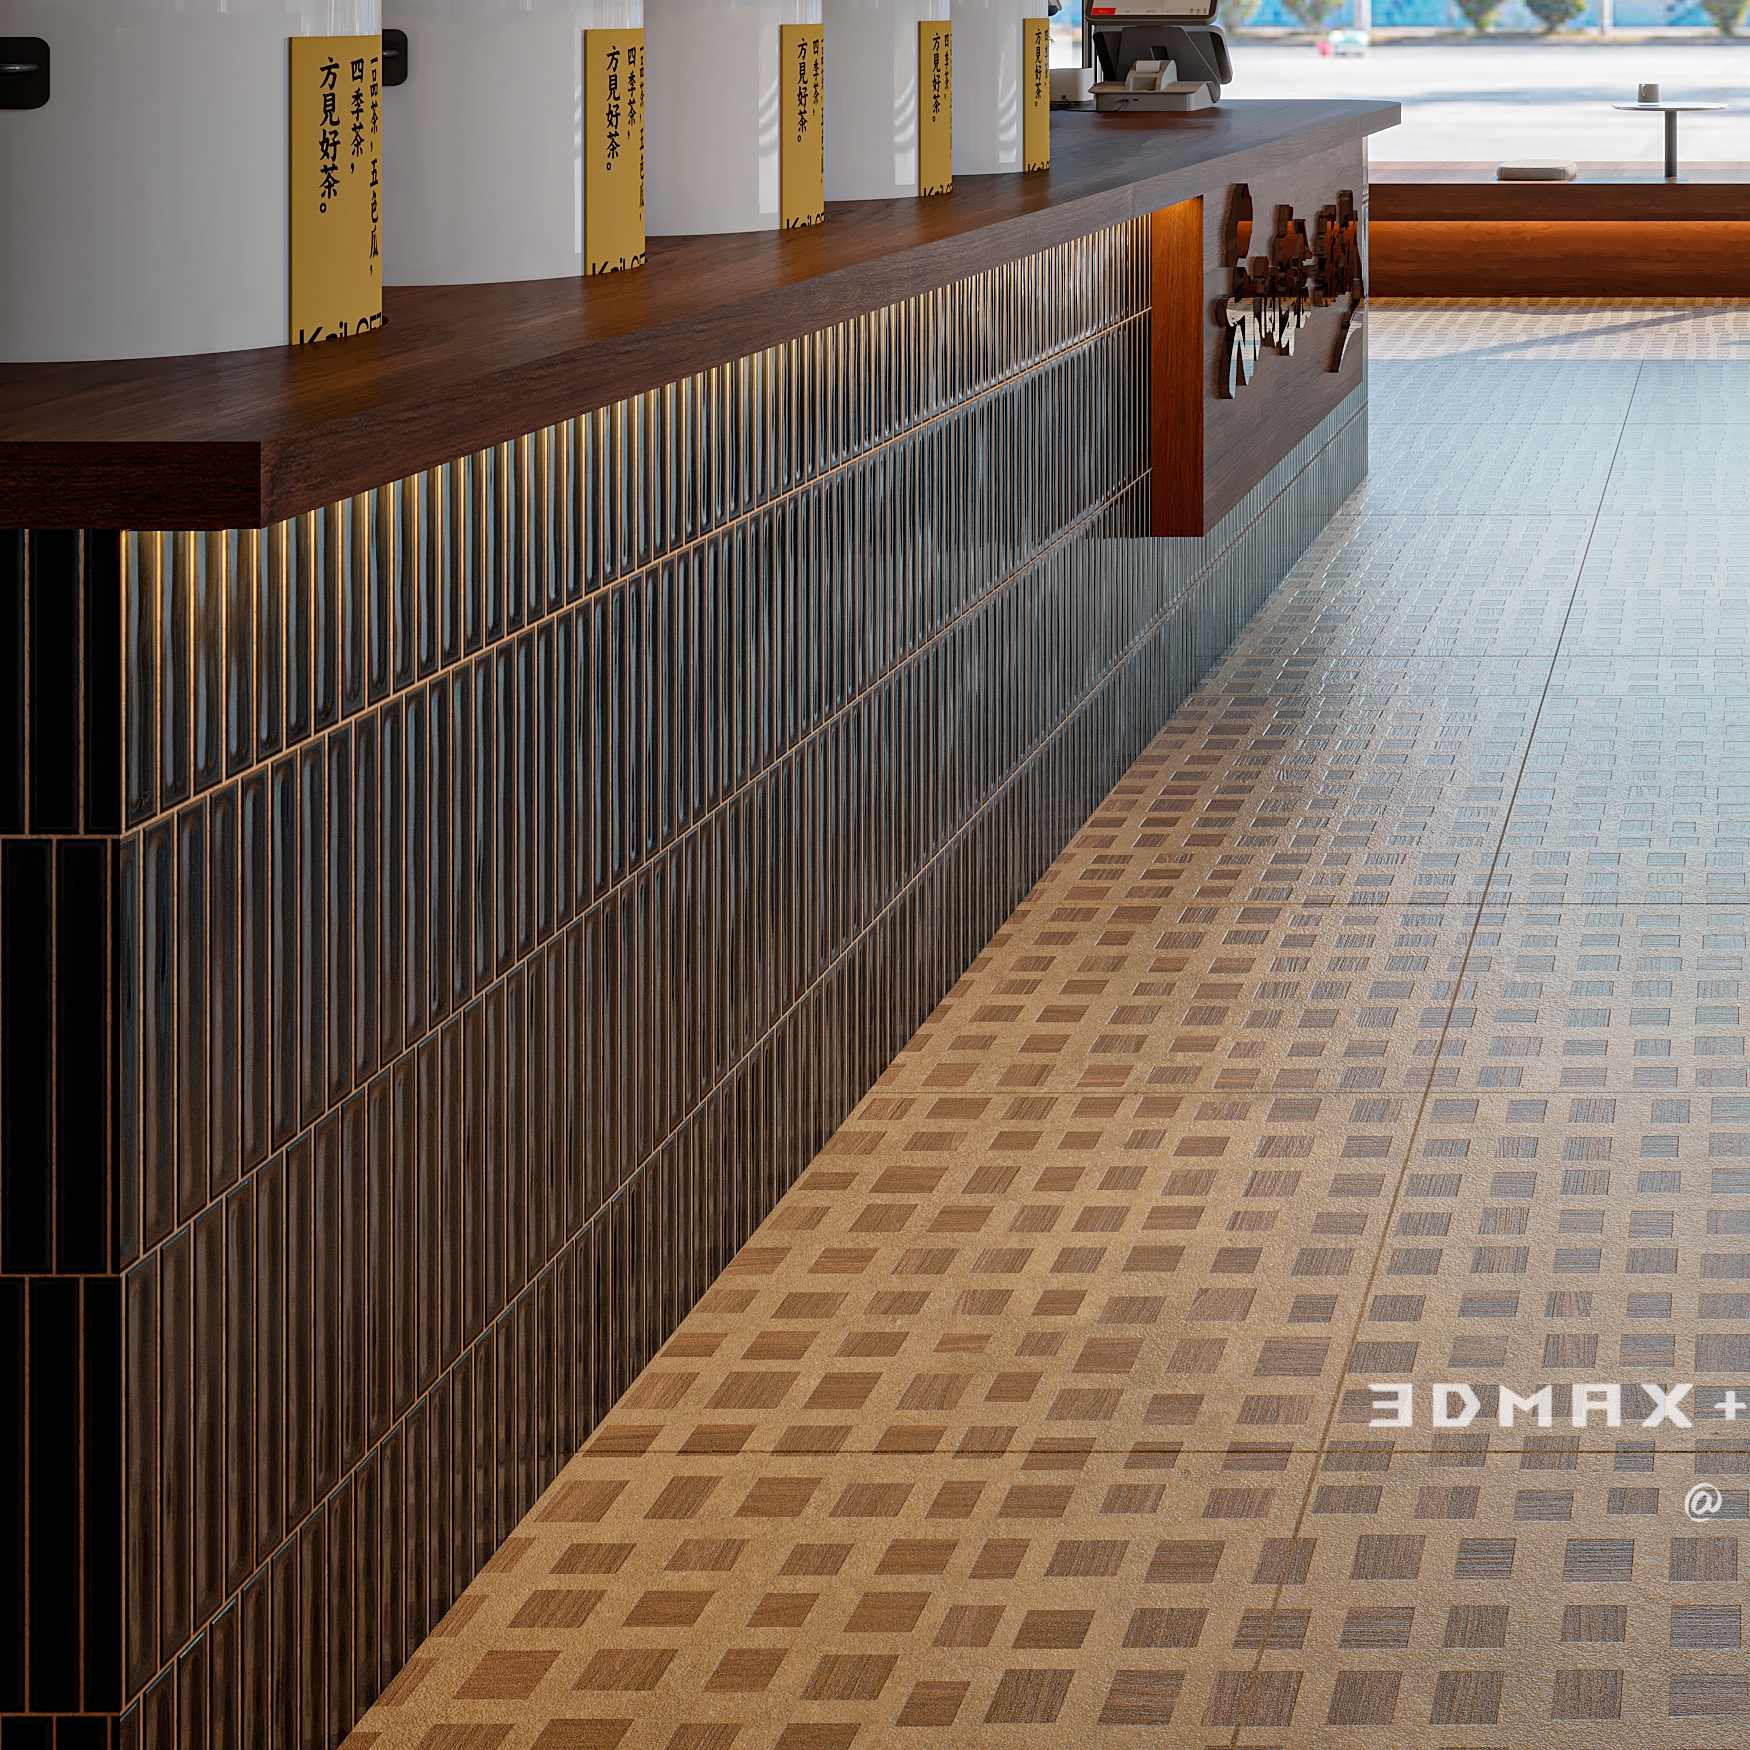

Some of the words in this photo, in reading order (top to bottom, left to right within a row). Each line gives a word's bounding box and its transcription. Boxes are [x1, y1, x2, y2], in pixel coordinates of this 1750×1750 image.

[319, 56, 340, 213] 方見好茶。
[606, 45, 621, 171] 方見好茶。
[797, 38, 808, 143] 方見好茶。
